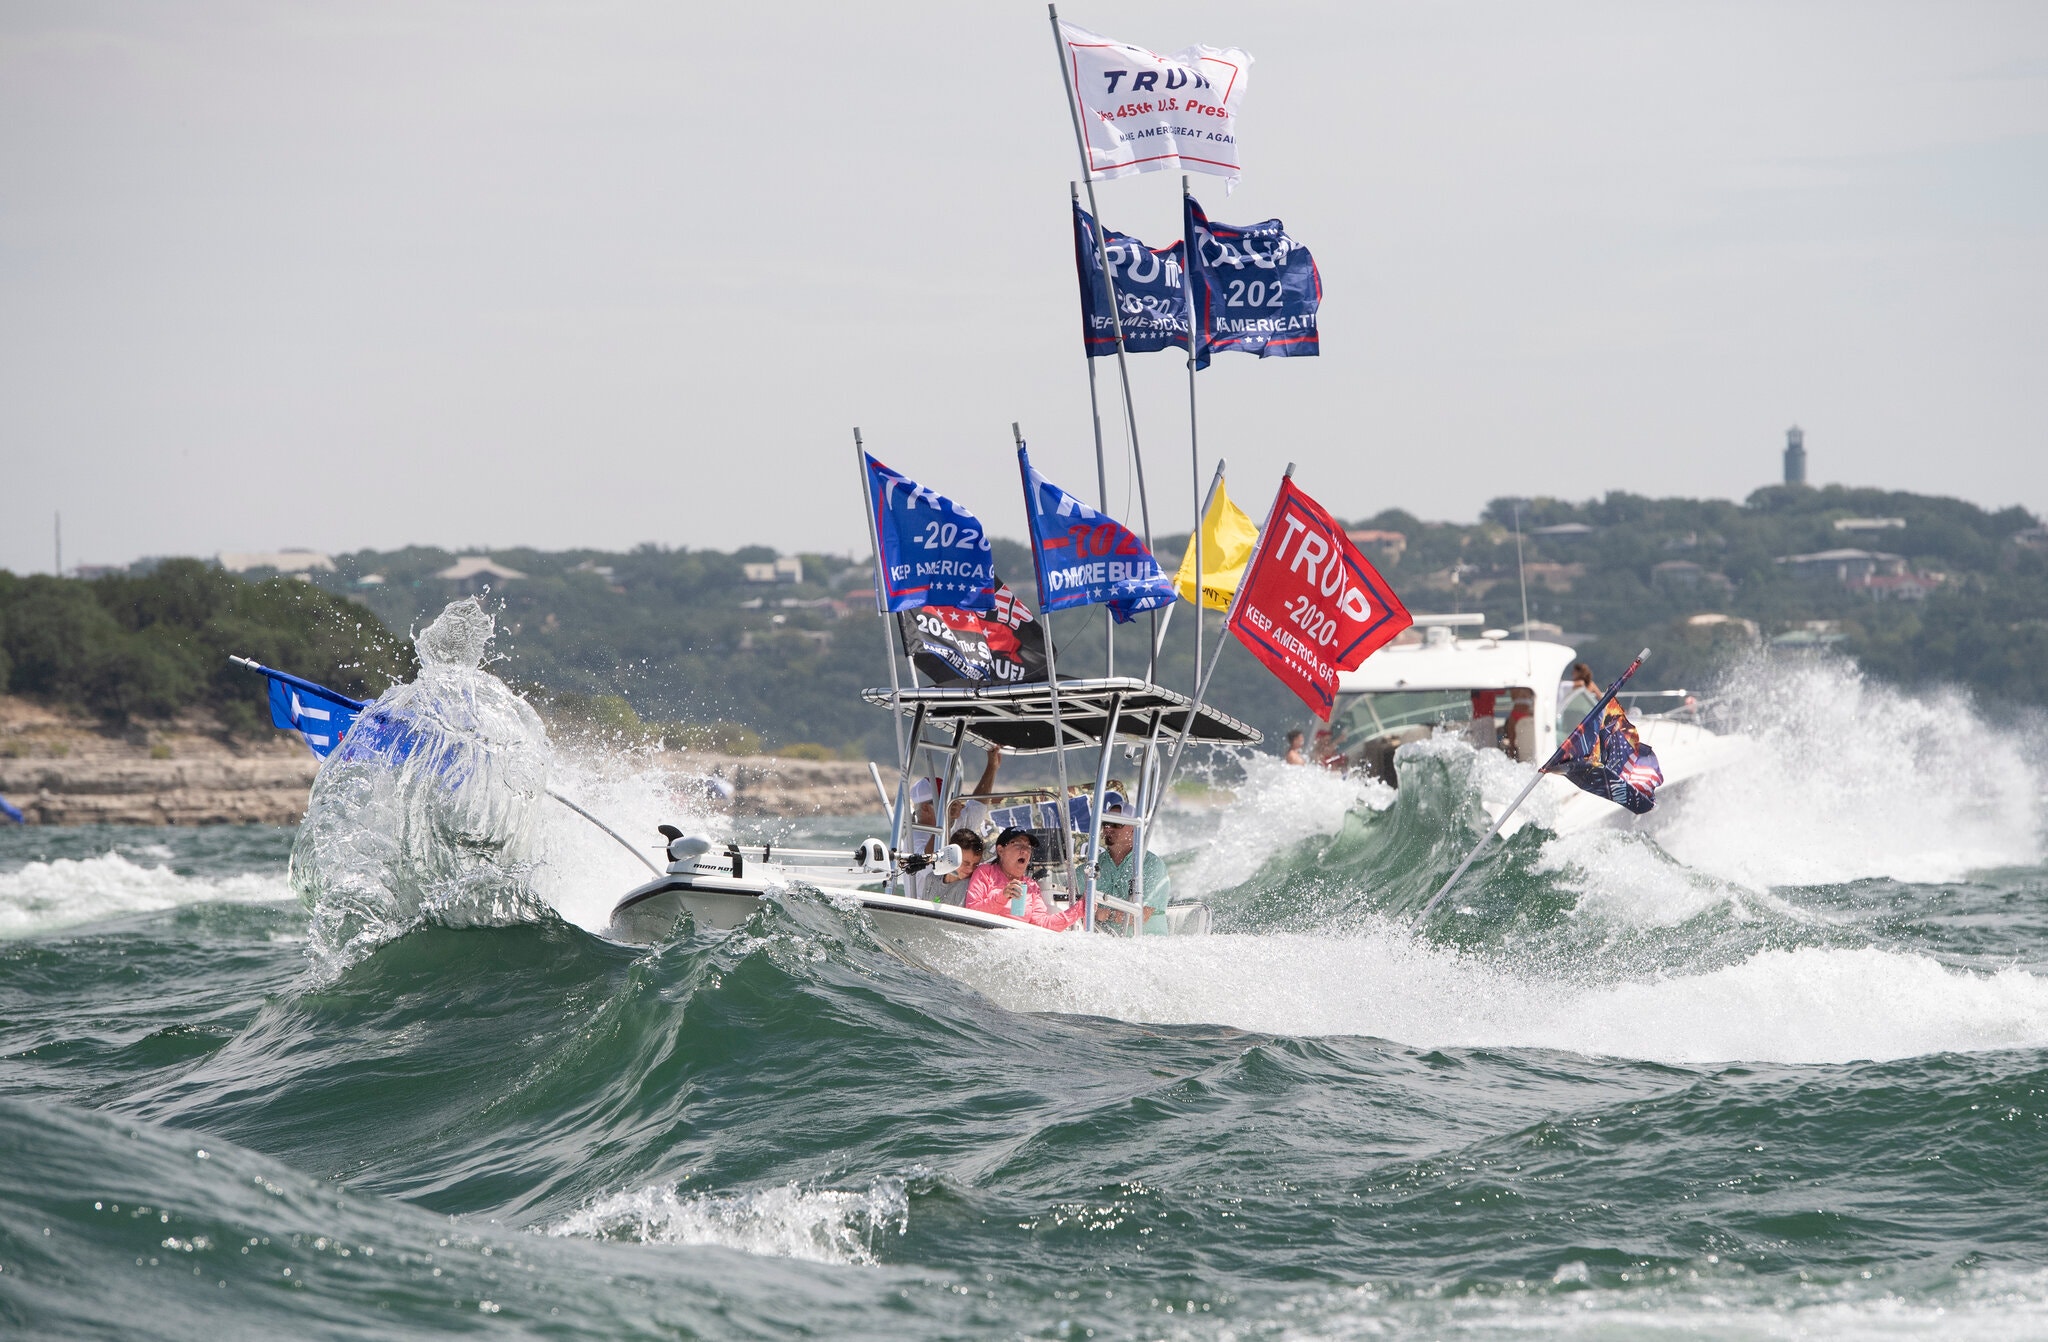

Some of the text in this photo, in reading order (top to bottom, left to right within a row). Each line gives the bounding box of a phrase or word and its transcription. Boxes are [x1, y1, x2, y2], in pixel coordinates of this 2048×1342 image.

[1117, 102, 1153, 118] 45th
[1158, 98, 1179, 112] U.S.
[1185, 99, 1229, 118] Pres
[1206, 132, 1237, 144] AGAI
[1245, 603, 1273, 636] KEEP
[1272, 628, 1320, 672] AMERICA
